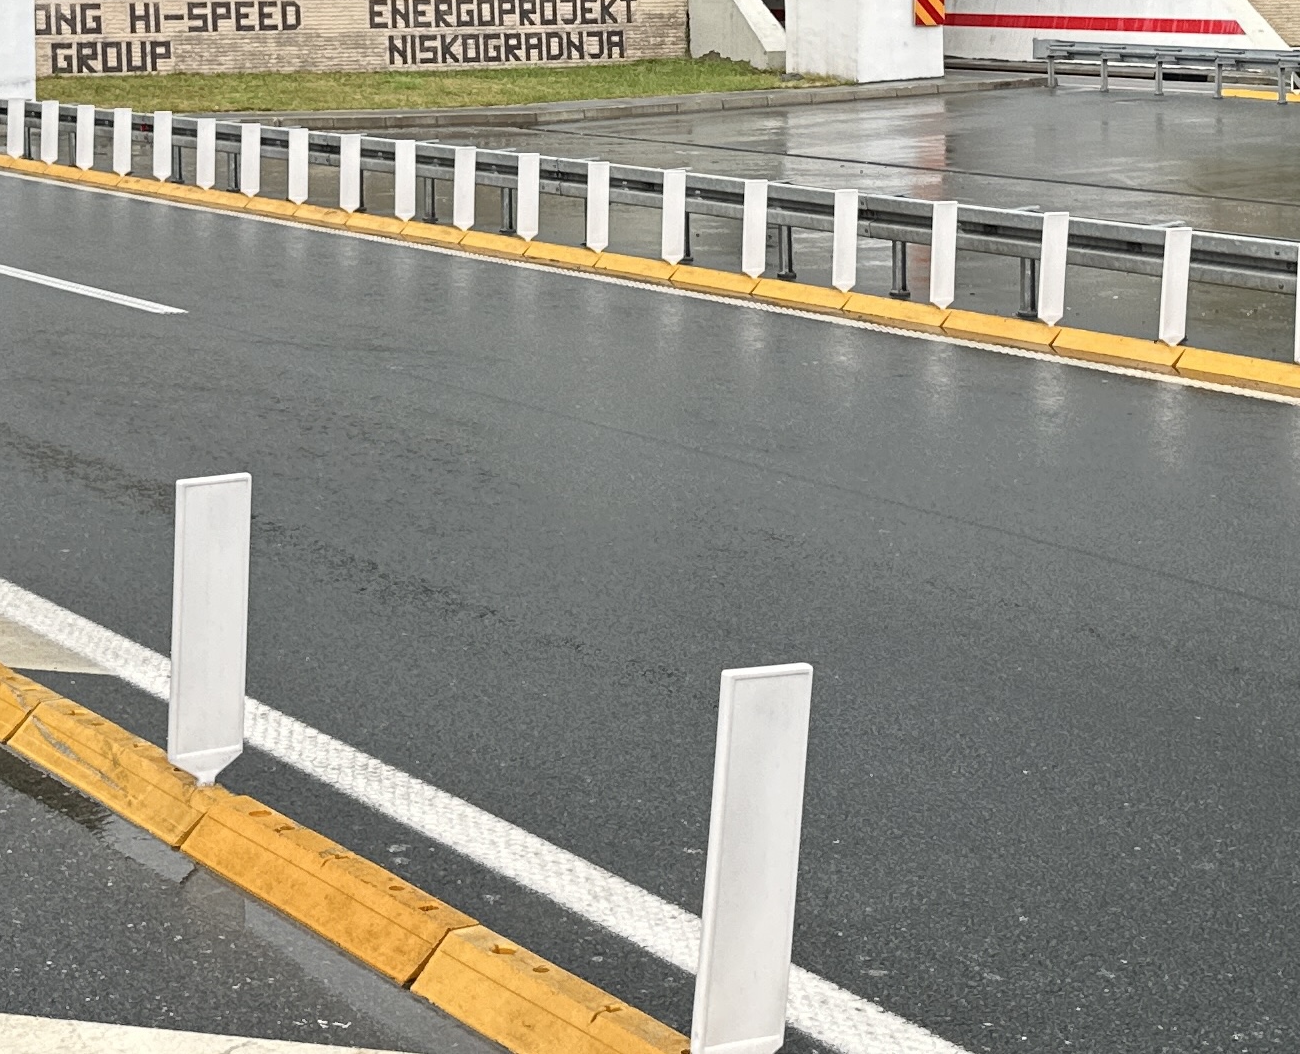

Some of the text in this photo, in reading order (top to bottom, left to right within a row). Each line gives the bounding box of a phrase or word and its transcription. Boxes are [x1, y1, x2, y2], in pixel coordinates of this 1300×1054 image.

[130, 1, 301, 33] HI-SPEED
[51, 41, 171, 74] GROUP
[388, 30, 624, 65] NISKOGRADNJA
